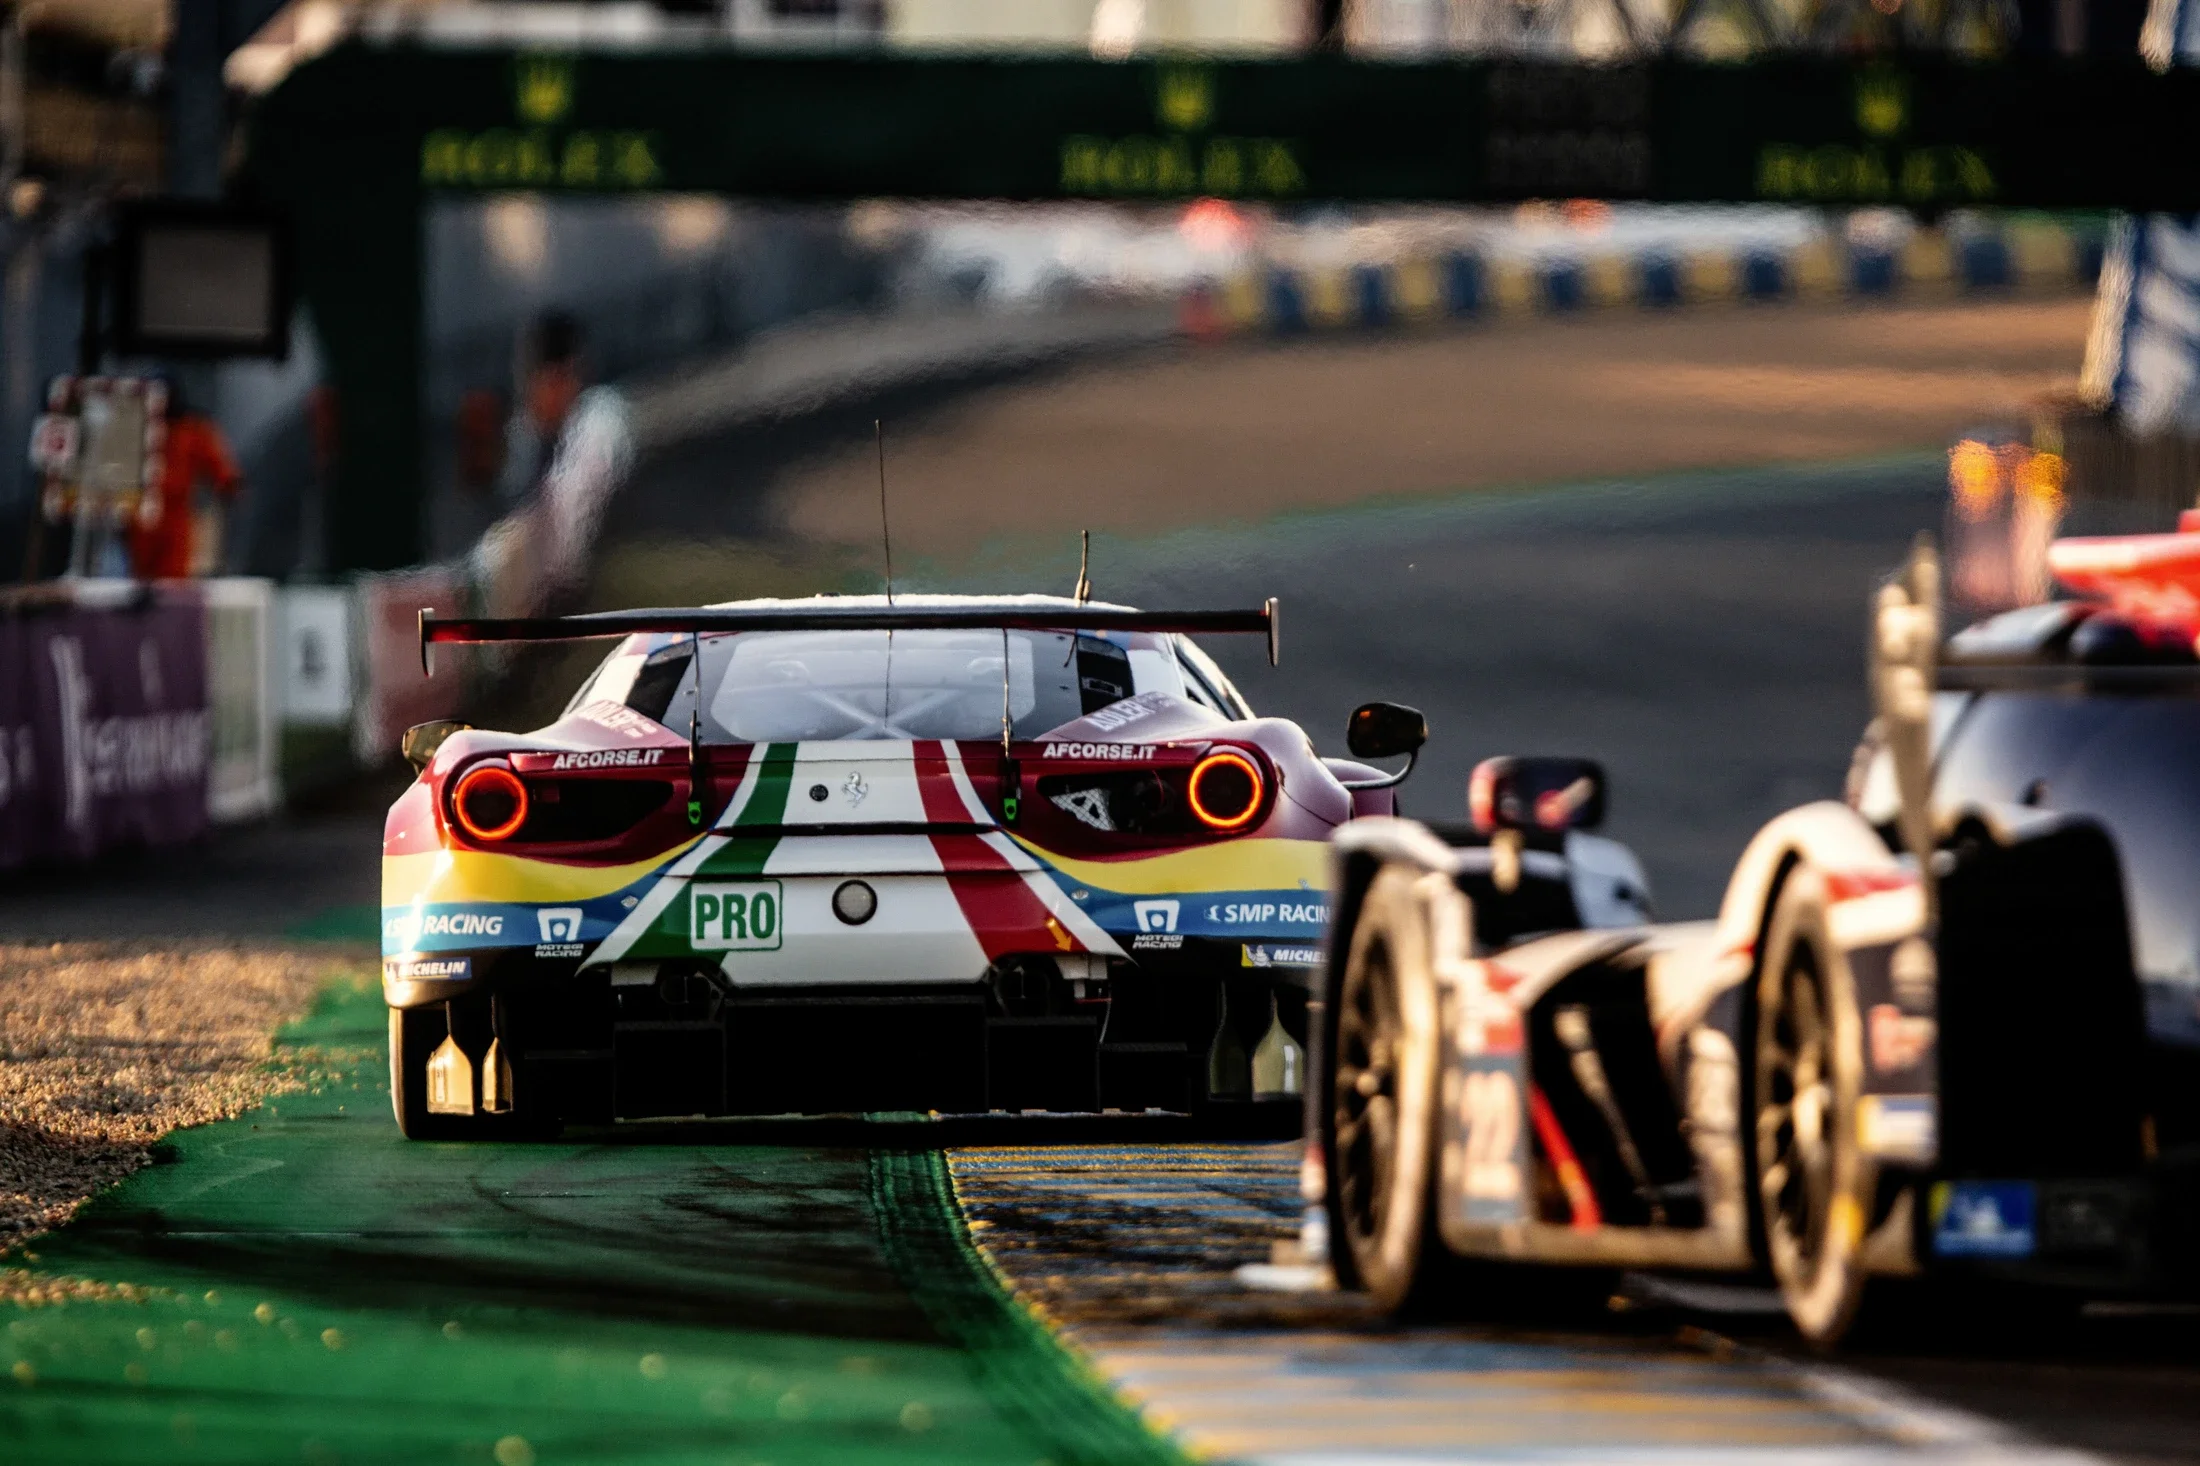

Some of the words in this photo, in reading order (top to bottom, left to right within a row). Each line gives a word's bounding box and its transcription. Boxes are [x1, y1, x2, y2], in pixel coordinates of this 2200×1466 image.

[553, 749, 664, 769] AFCORSE.IT
[1042, 742, 1157, 760] AFCORSE.IT
[695, 892, 776, 940] PRO
[1224, 904, 1275, 922] SMP
[1279, 904, 1331, 922] RACIN
[424, 914, 503, 935] RACING
[534, 950, 583, 958] RACING
[1132, 941, 1182, 949] RACING
[1273, 949, 1328, 962] MICHE
